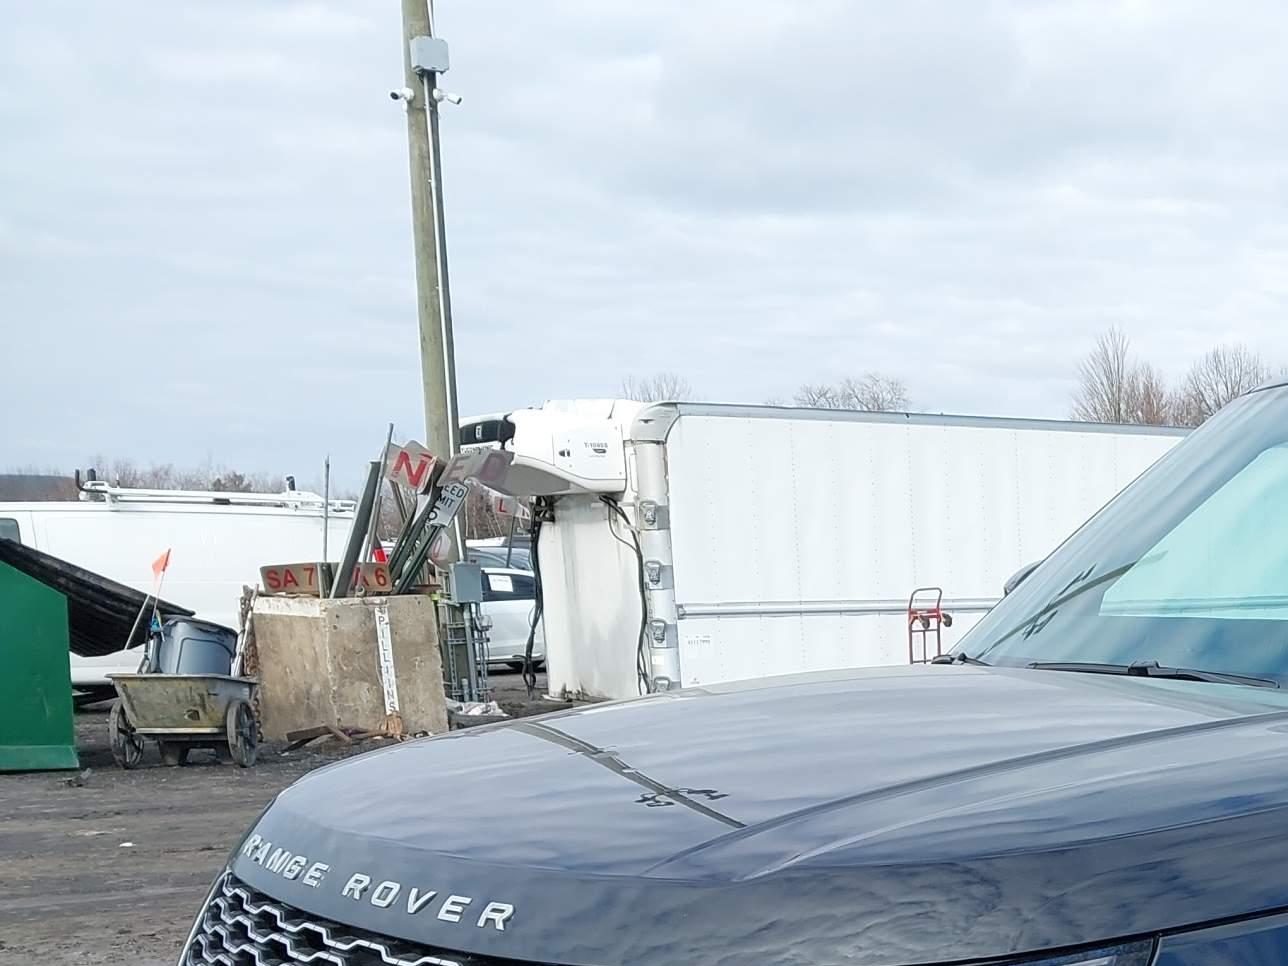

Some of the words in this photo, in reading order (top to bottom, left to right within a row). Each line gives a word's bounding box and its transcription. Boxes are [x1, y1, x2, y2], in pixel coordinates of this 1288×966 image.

[266, 569, 299, 589] SA
[303, 567, 315, 586] 7
[374, 567, 388, 587] 6
[243, 833, 331, 888] RANGE
[342, 872, 515, 932] ROVER
